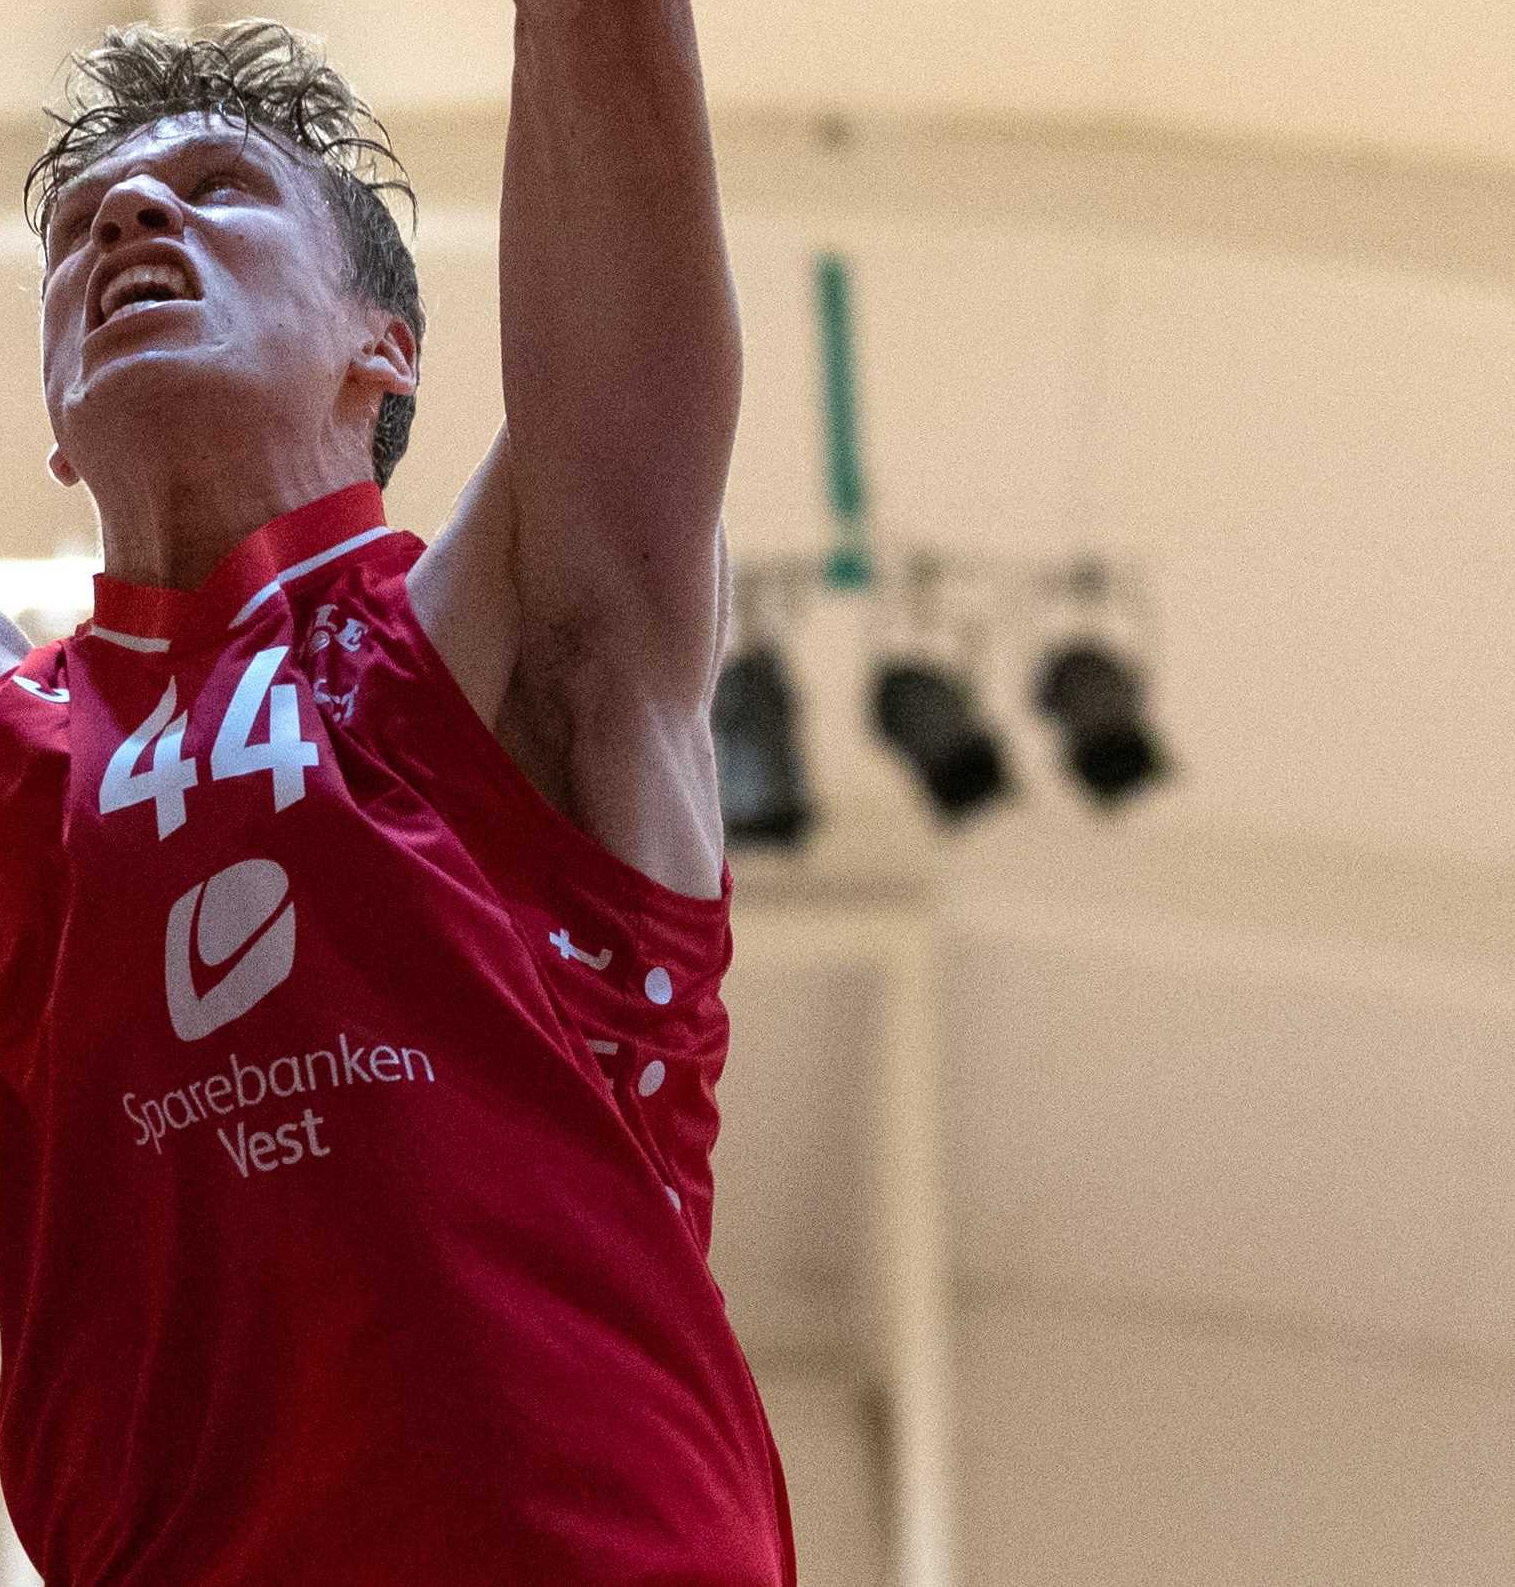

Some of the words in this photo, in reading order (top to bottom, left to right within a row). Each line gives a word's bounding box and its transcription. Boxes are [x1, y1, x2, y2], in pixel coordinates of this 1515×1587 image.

[98, 646, 319, 840] 44
[122, 1033, 435, 1155] Sparebanken
[216, 1108, 331, 1179] Vest
